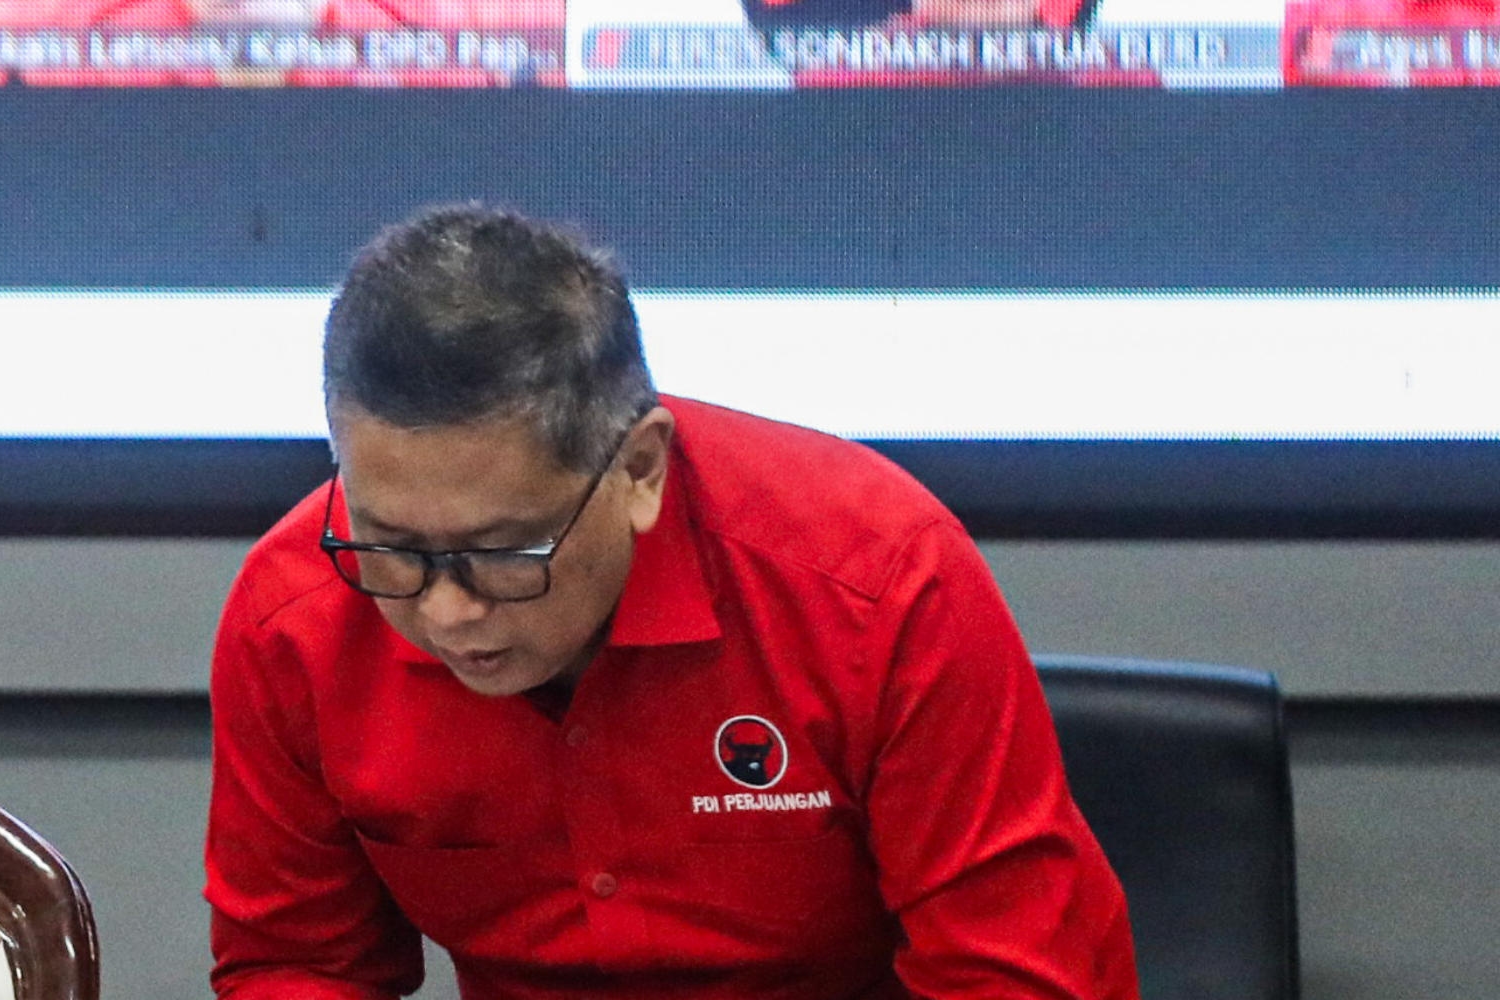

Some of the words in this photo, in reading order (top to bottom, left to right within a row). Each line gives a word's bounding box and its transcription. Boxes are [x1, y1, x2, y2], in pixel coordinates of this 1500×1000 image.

[770, 31, 971, 68] SONDAKH
[692, 796, 719, 813] PDI
[723, 790, 832, 812] PERJUANGAN
